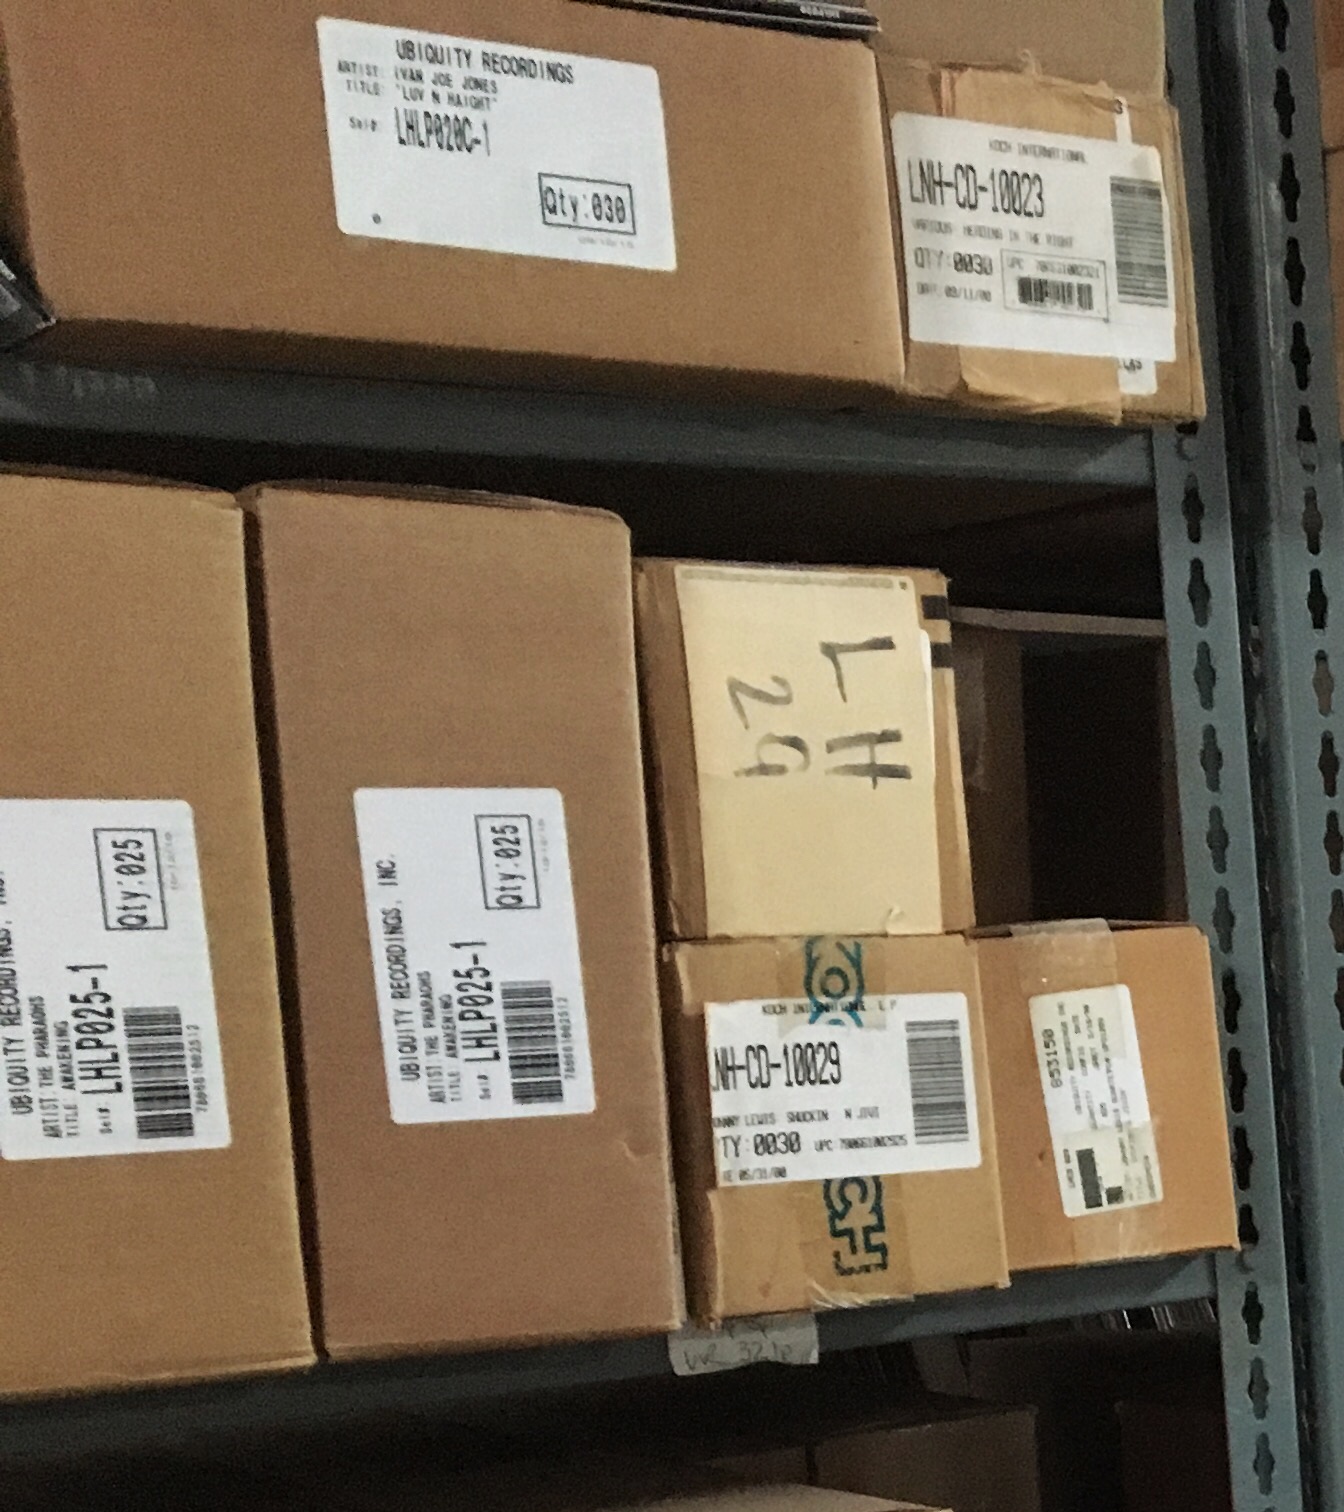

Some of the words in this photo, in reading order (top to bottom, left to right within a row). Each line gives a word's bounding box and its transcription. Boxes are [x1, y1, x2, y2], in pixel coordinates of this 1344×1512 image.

[395, 66, 423, 83] IVAN
[432, 71, 453, 88] JOE
[462, 75, 498, 94] JONES
[396, 37, 471, 69] UBIQUITY
[482, 55, 574, 84] RECORDINGS
[394, 107, 491, 157] LHLP020C-1
[543, 186, 626, 225] Qty:030
[908, 158, 1045, 218] LNH-CD-10023
[111, 837, 151, 930] Qty:025
[376, 854, 398, 887] INC.
[491, 823, 527, 909] Qty:025
[66, 963, 123, 1095] LHLP025-1
[449, 941, 500, 1062] LHLP025-1
[5, 1036, 33, 1115] UBIQUITY
[54, 1020, 76, 1091] AWAKENING
[396, 1009, 421, 1082] UBIQUITY
[712, 1040, 842, 1092] NH-CD-10029
